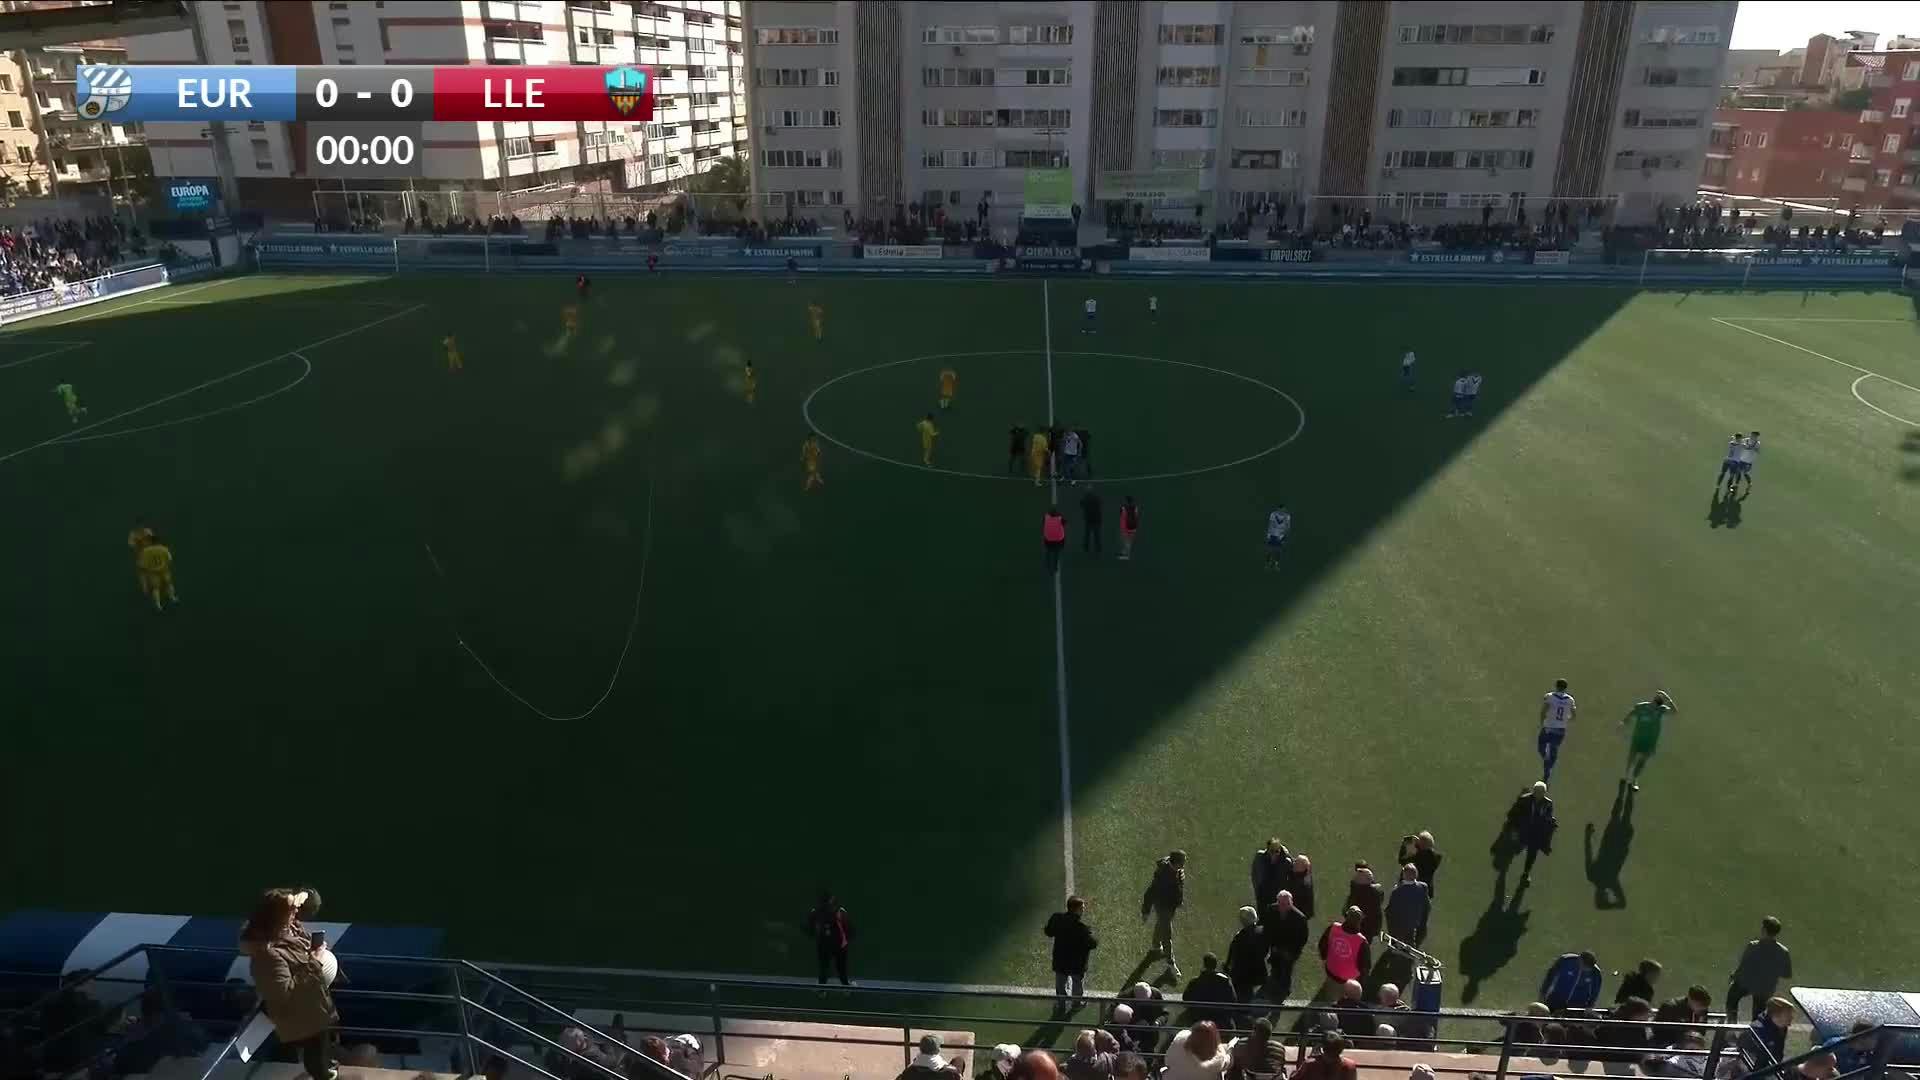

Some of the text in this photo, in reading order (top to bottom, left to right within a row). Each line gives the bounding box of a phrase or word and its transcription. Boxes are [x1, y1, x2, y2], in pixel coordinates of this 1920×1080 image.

[171, 185, 209, 197] EUROPA
[754, 249, 788, 257] ESTRELLA
[1421, 254, 1459, 263] ESTRELLA
[1555, 706, 1564, 721] 9
